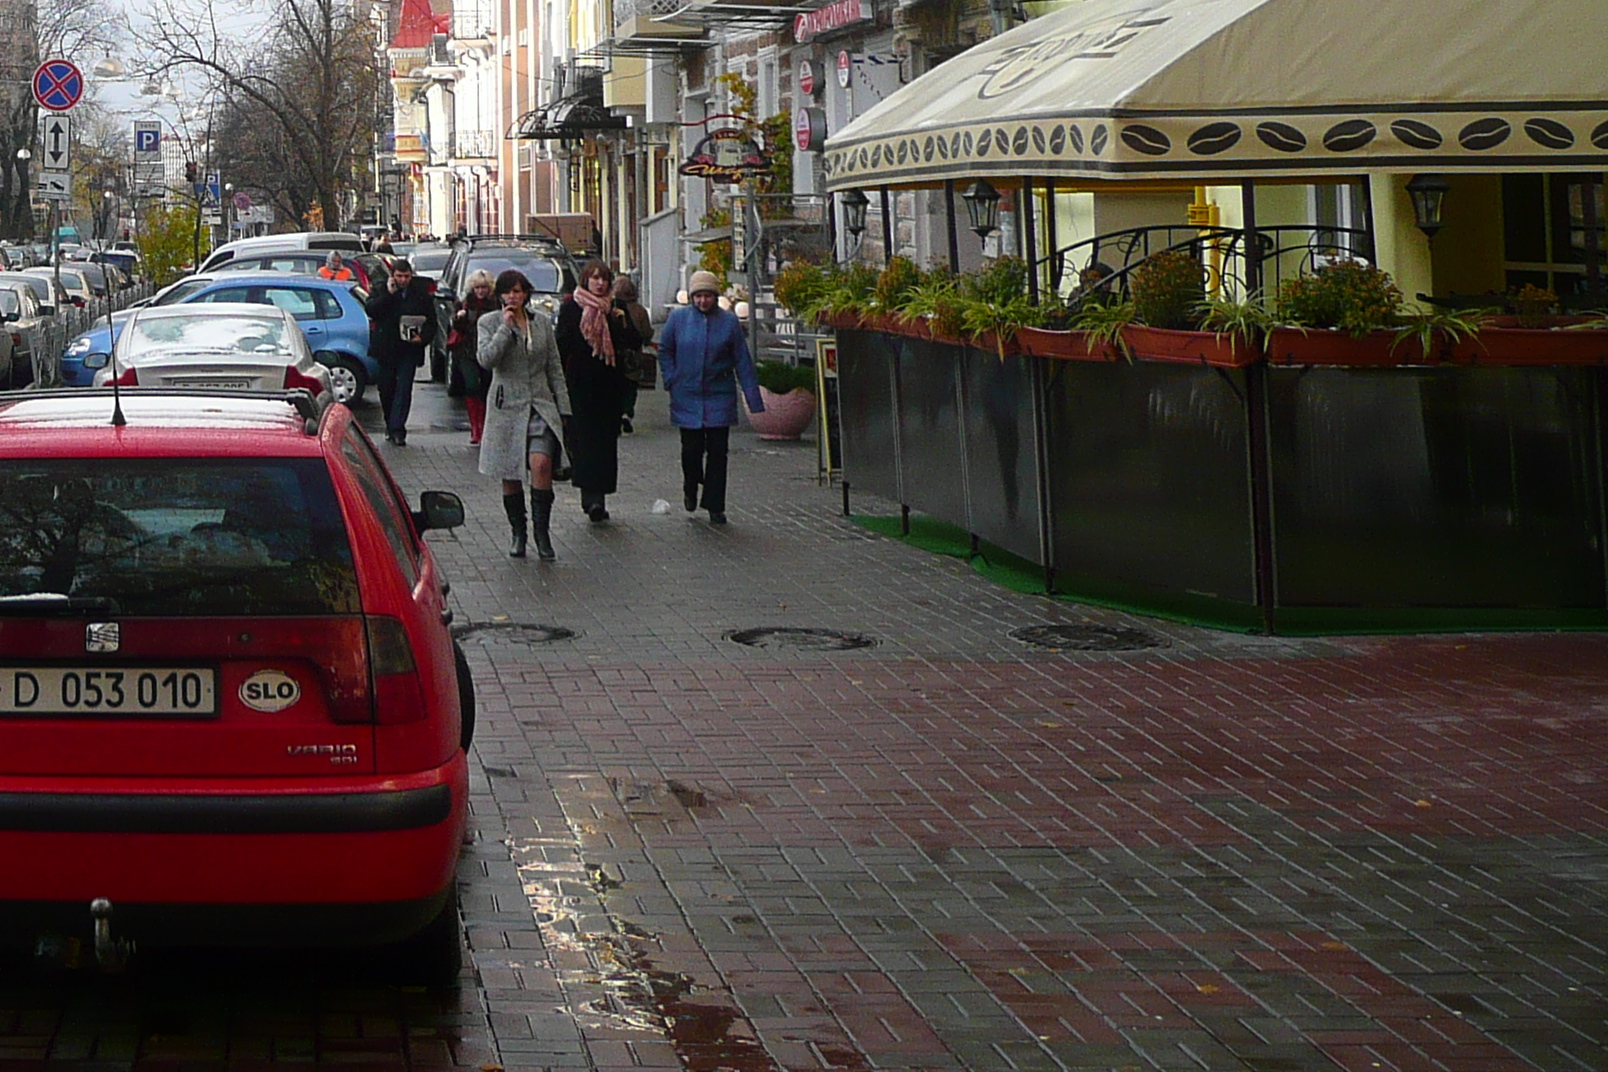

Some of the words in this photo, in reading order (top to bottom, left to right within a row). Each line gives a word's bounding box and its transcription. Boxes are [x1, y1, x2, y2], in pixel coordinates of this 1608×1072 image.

[142, 132, 155, 150] P
[13, 671, 40, 708] D
[61, 671, 125, 708] 053
[137, 671, 201, 709] 010
[246, 681, 294, 700] SLO
[287, 744, 357, 755] VARIO
